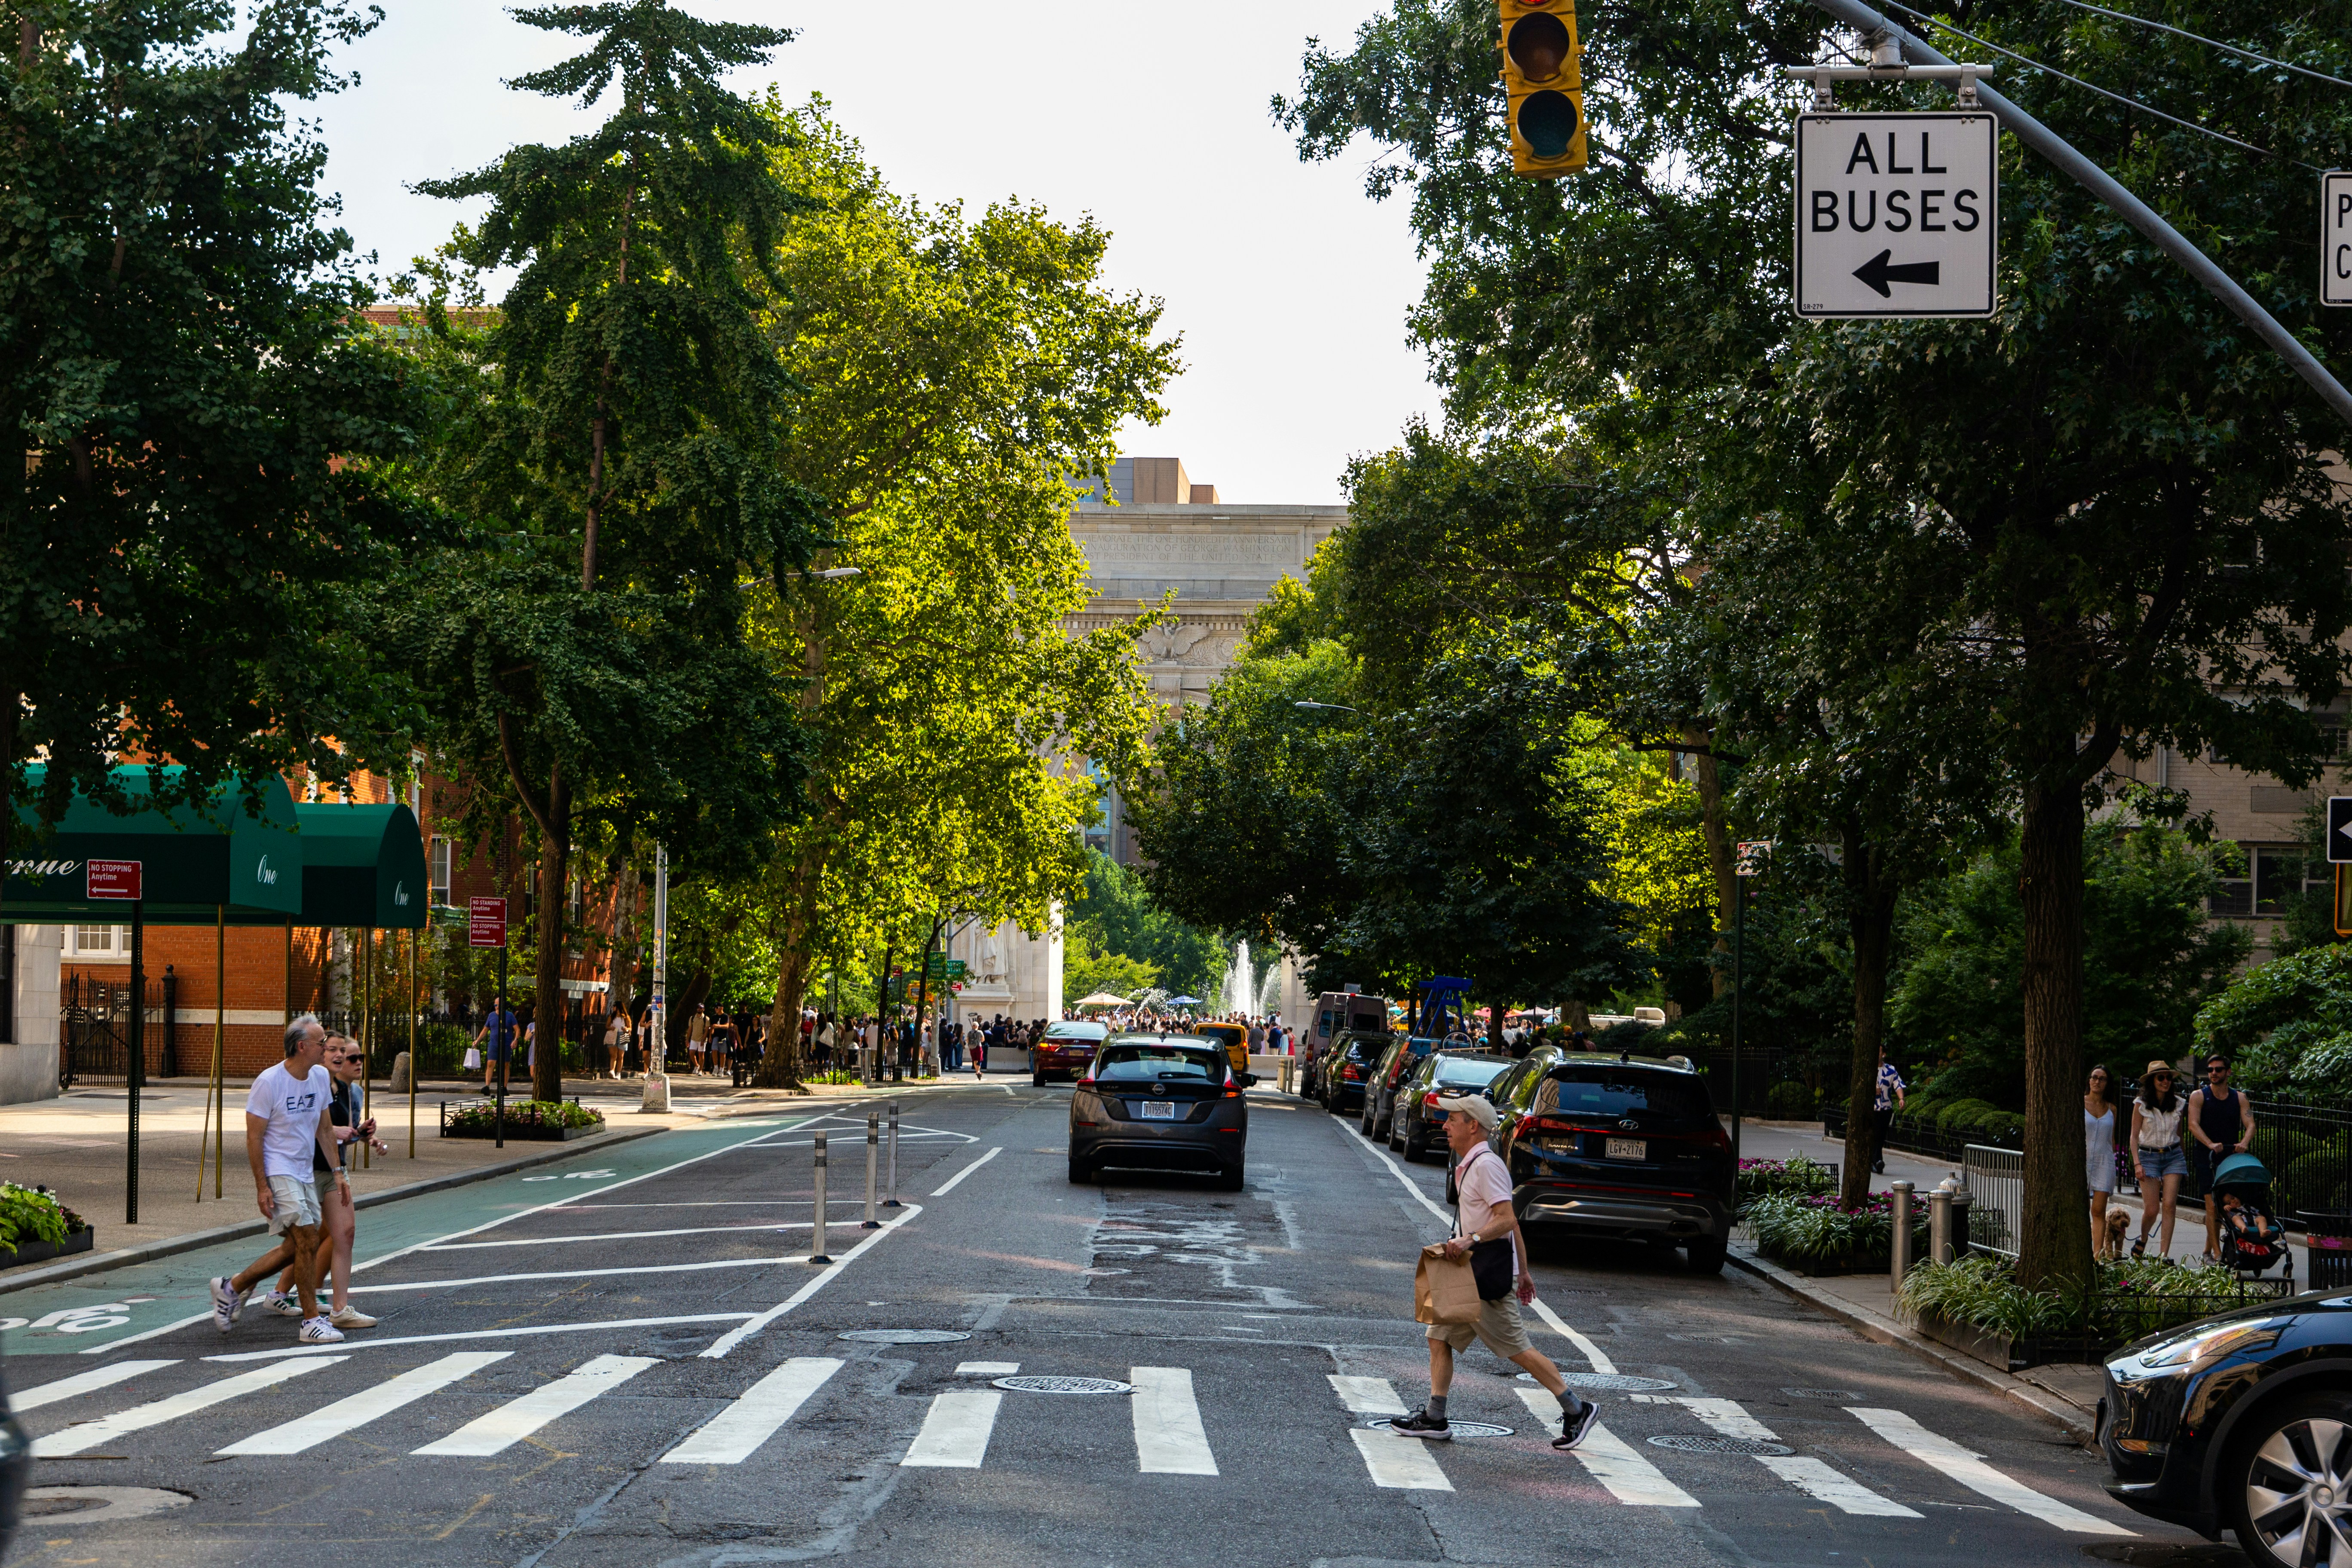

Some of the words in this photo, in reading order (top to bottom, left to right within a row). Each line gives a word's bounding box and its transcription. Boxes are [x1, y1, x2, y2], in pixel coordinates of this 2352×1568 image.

[1845, 132, 1947, 174] ALL
[1811, 189, 1979, 232] BUSES
[1136, 535, 1154, 543] THE
[1176, 536, 1229, 544] HUNDREDTH
[1231, 536, 1292, 544] ANNIVERSARY
[1164, 544, 1178, 552] OF
[1180, 544, 1219, 552] GEORGE
[1223, 545, 1291, 553] WASHINGTON
[1103, 552, 1155, 560] PRESIDENT
[1159, 552, 1172, 561] OF
[1178, 553, 1197, 561] THE
[1202, 553, 1239, 561] UNITED
[257, 854, 278, 884] One
[91, 873, 117, 882] Anytime
[395, 880, 410, 906] One
[286, 1093, 317, 1111] EA7
[1145, 1106, 1171, 1115] T115574C
[1609, 1143, 1623, 1154] LGV
[1626, 1145, 1643, 1155] 2176
